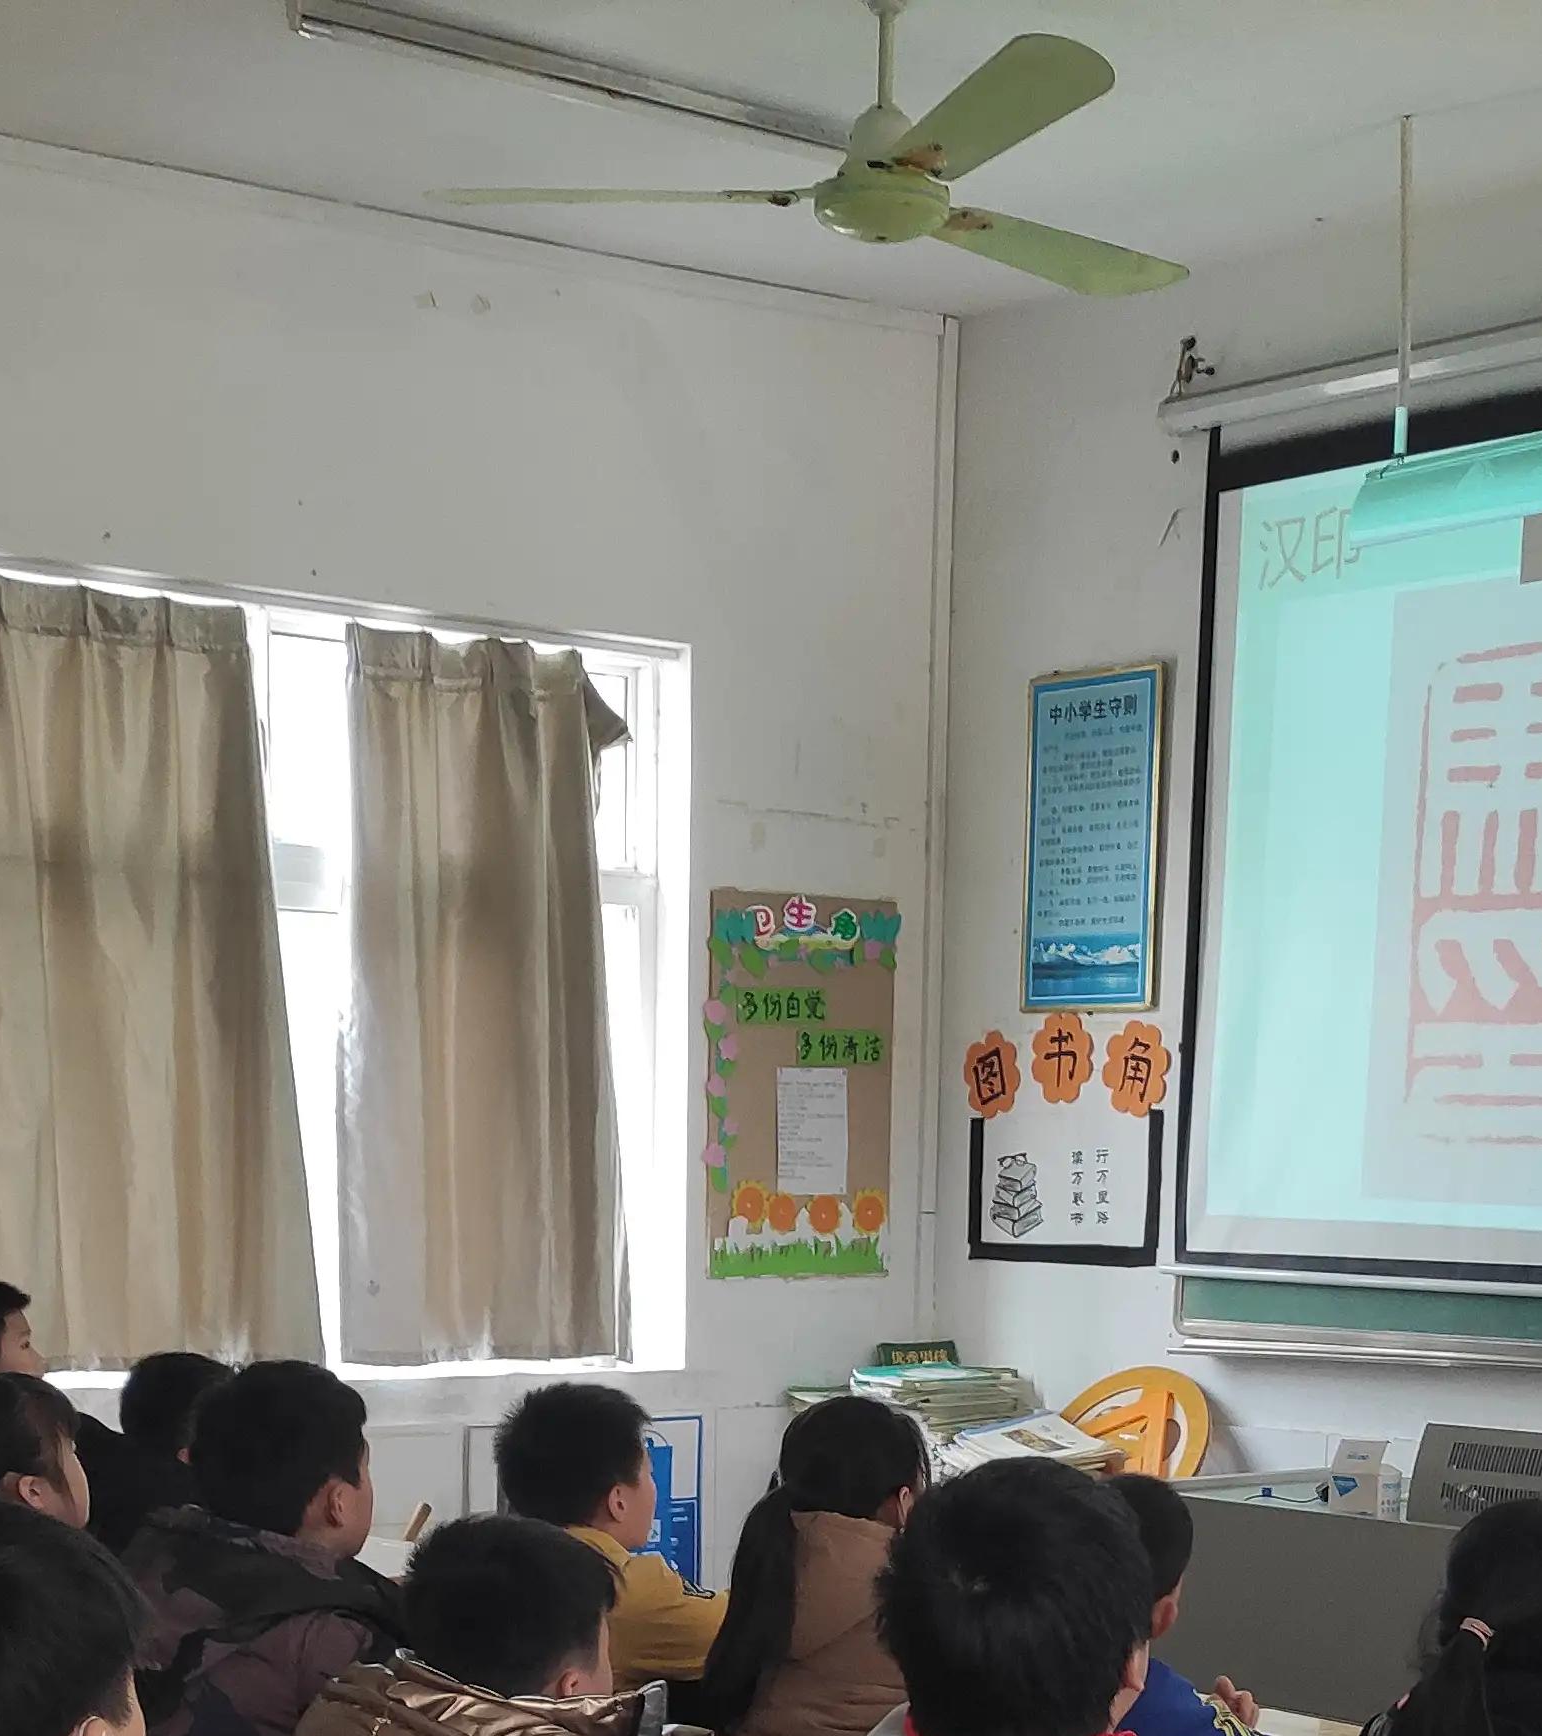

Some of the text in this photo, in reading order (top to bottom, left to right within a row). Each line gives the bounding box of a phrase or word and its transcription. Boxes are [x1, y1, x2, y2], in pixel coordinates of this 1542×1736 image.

[1259, 506, 1360, 590] 汉印
[1049, 694, 1139, 725] 中小学生守则
[973, 1028, 1152, 1105] 图书角
